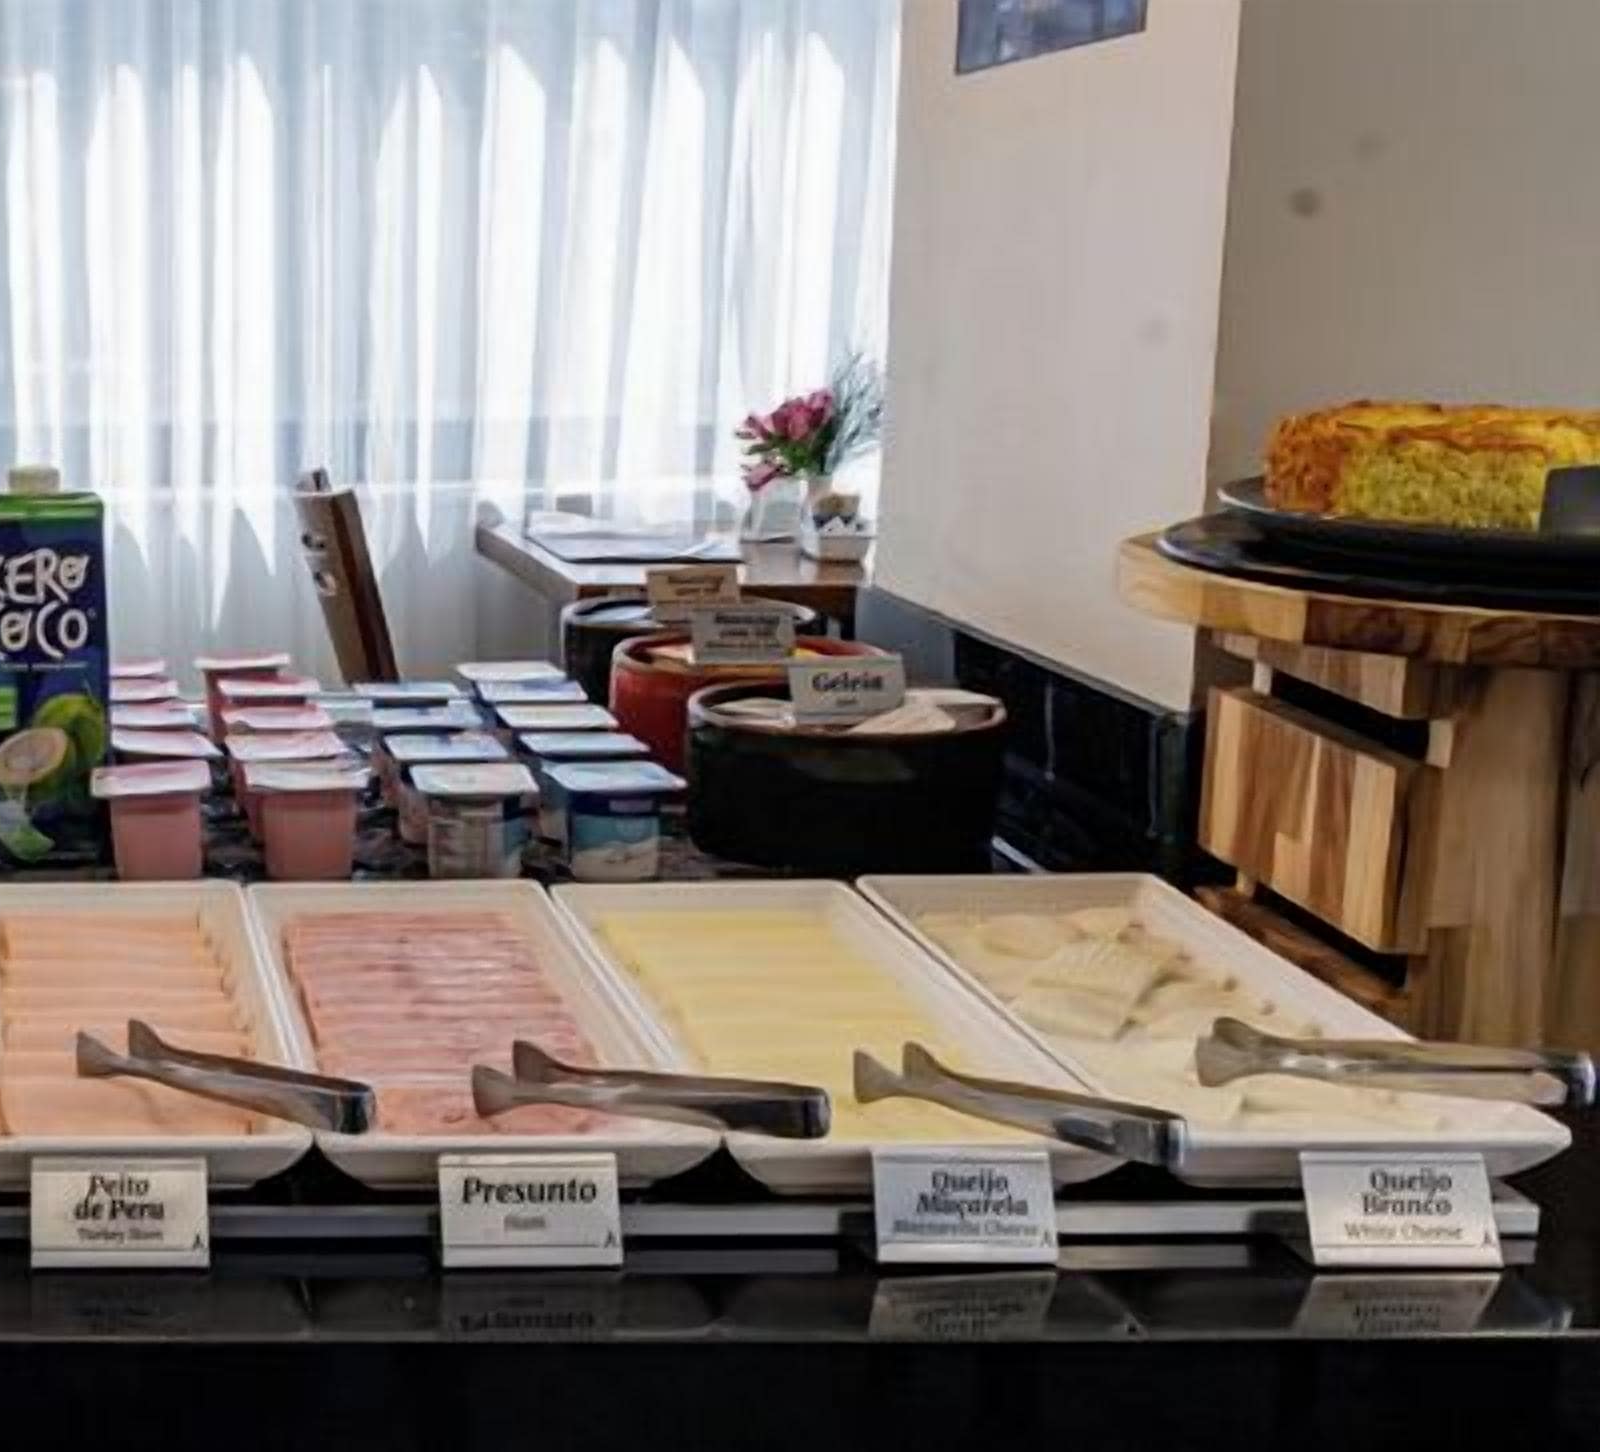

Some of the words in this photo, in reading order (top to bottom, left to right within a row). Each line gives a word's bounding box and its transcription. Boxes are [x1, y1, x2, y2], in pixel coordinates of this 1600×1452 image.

[85, 1175, 150, 1207] Peito
[462, 1176, 597, 1204] Presunto
[932, 1169, 1009, 1200] Queijo
[1369, 1168, 1452, 1200] Queijo
[74, 1199, 104, 1220] de
[108, 1198, 164, 1220] Peru
[1363, 1194, 1452, 1215] Branco
